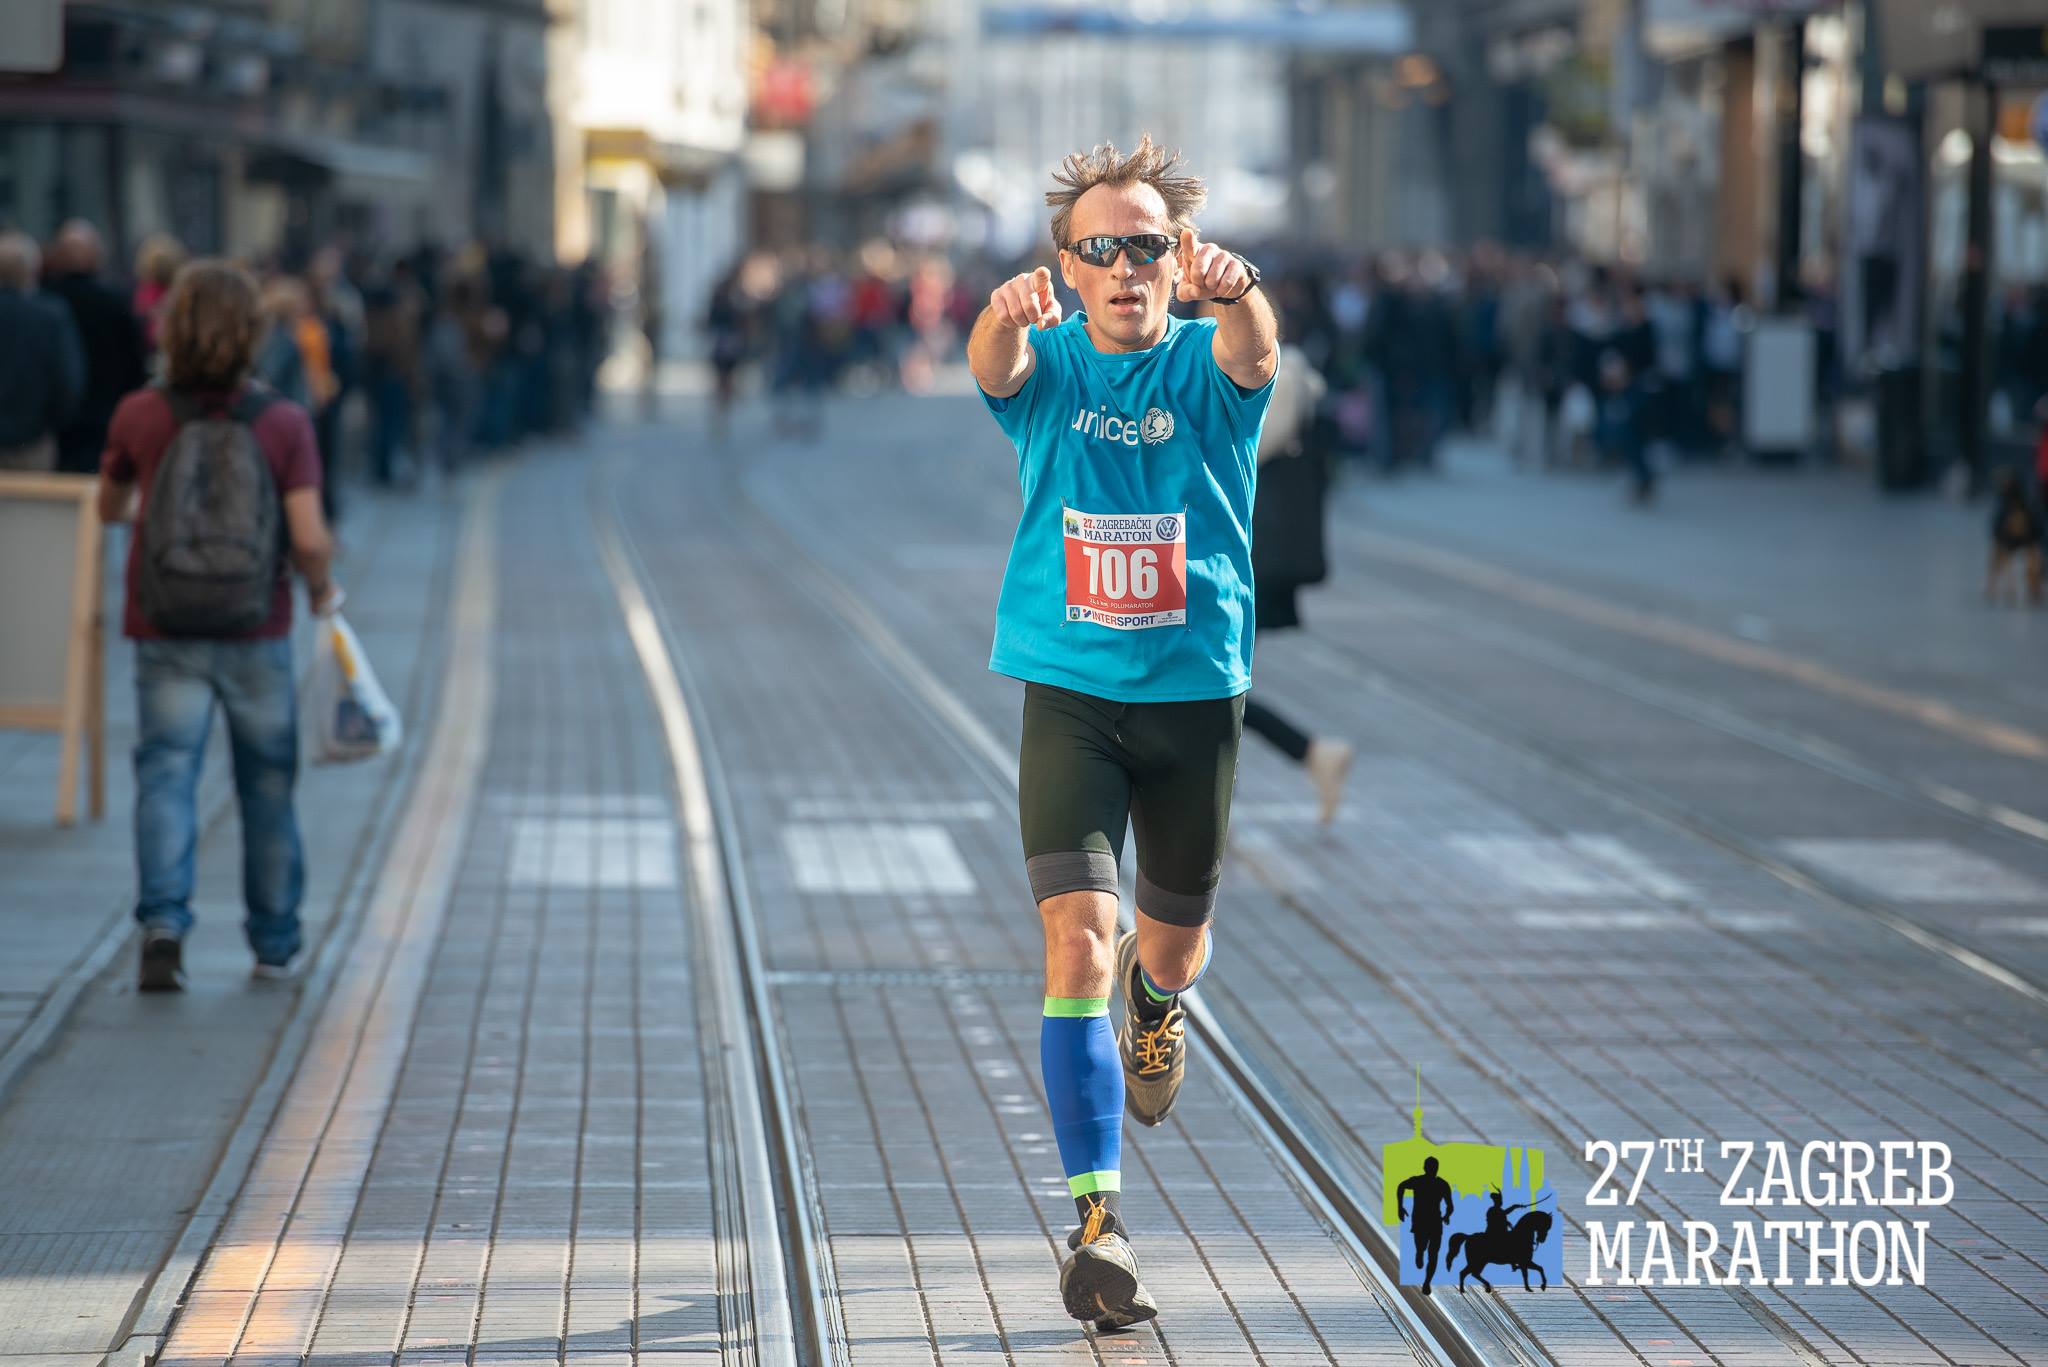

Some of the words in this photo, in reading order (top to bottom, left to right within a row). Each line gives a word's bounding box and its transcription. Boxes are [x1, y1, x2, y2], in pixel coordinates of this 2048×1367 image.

[1071, 404, 1139, 446] unice
[1083, 517, 1095, 529] 27.
[1096, 517, 1152, 530] ZAGREBAČKI
[1083, 529, 1152, 542] MARATON
[1082, 545, 1159, 600] 706
[1091, 609, 1156, 627] INTERSPORT
